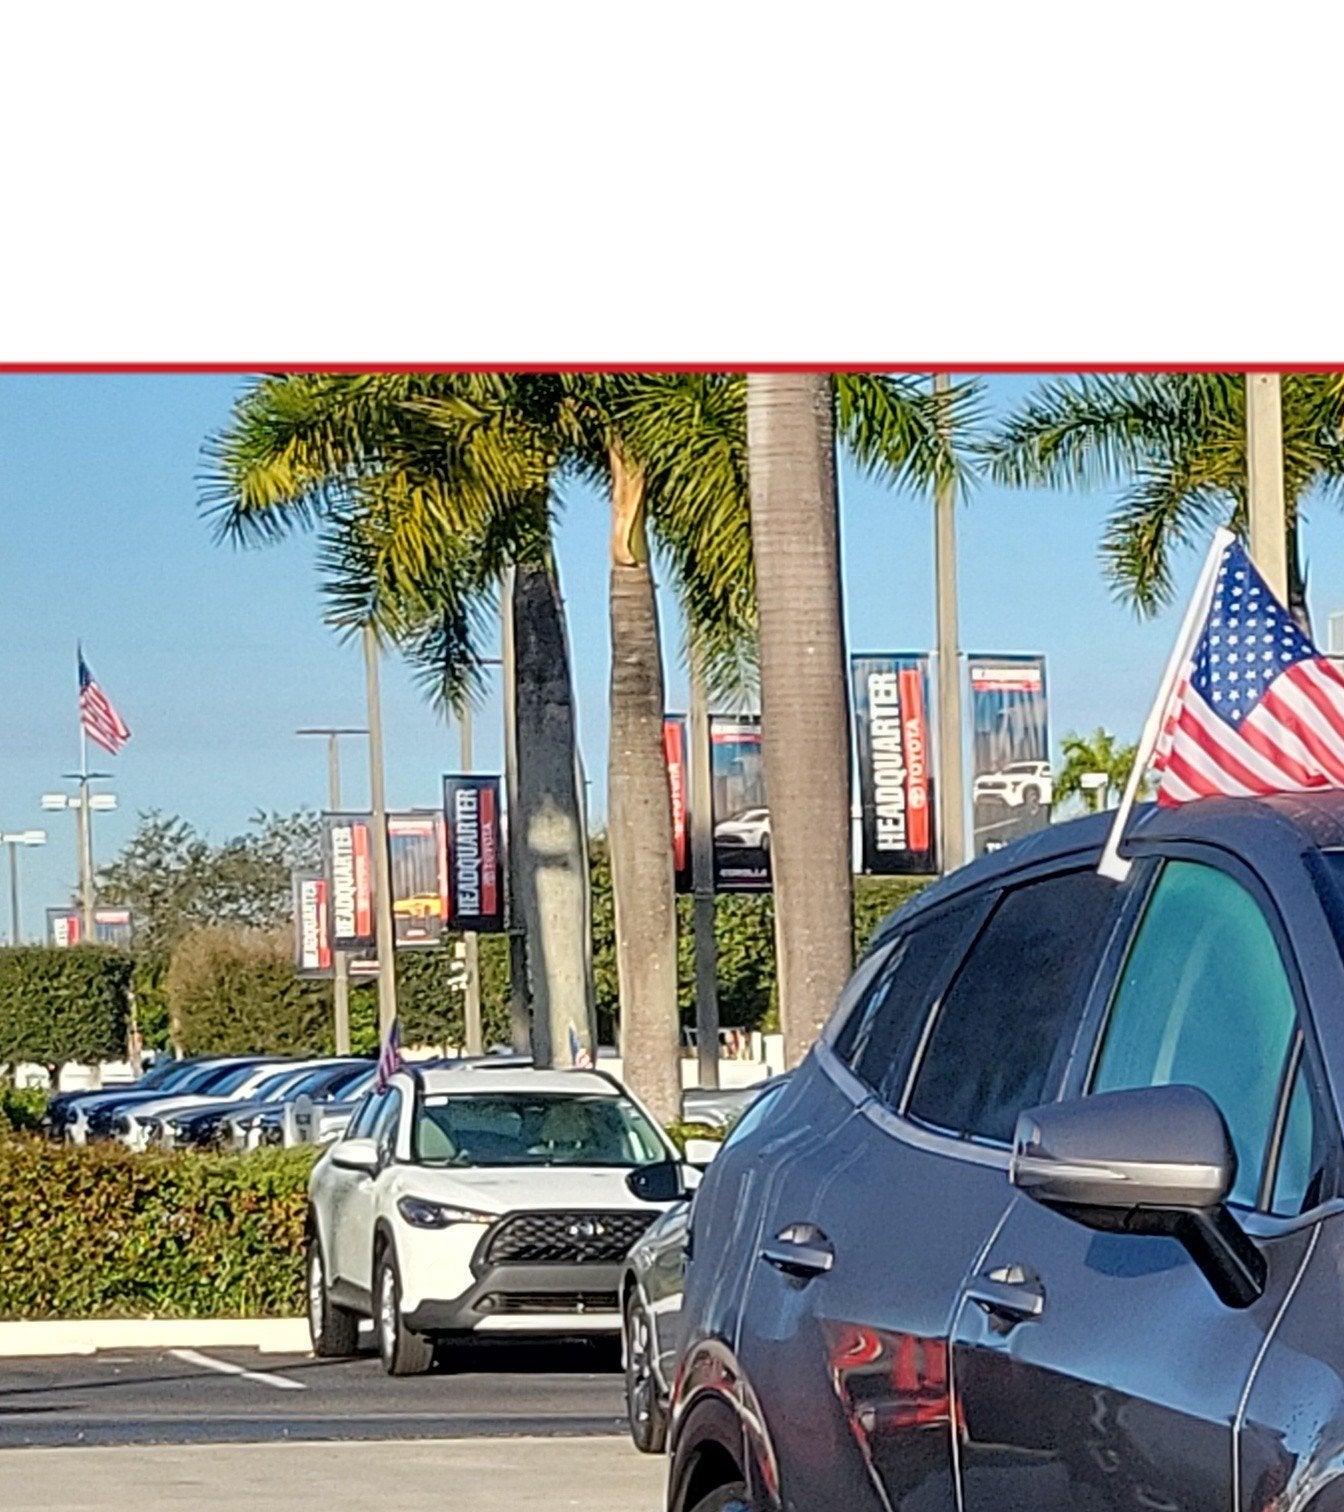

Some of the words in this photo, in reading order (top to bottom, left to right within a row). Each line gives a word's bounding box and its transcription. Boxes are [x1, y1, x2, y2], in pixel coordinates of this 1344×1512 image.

[868, 672, 907, 852] HEADQUARTER
[906, 718, 924, 785] TOYOTA
[332, 826, 357, 938] HEADQUARTER
[455, 788, 481, 916] HEADQUARTER
